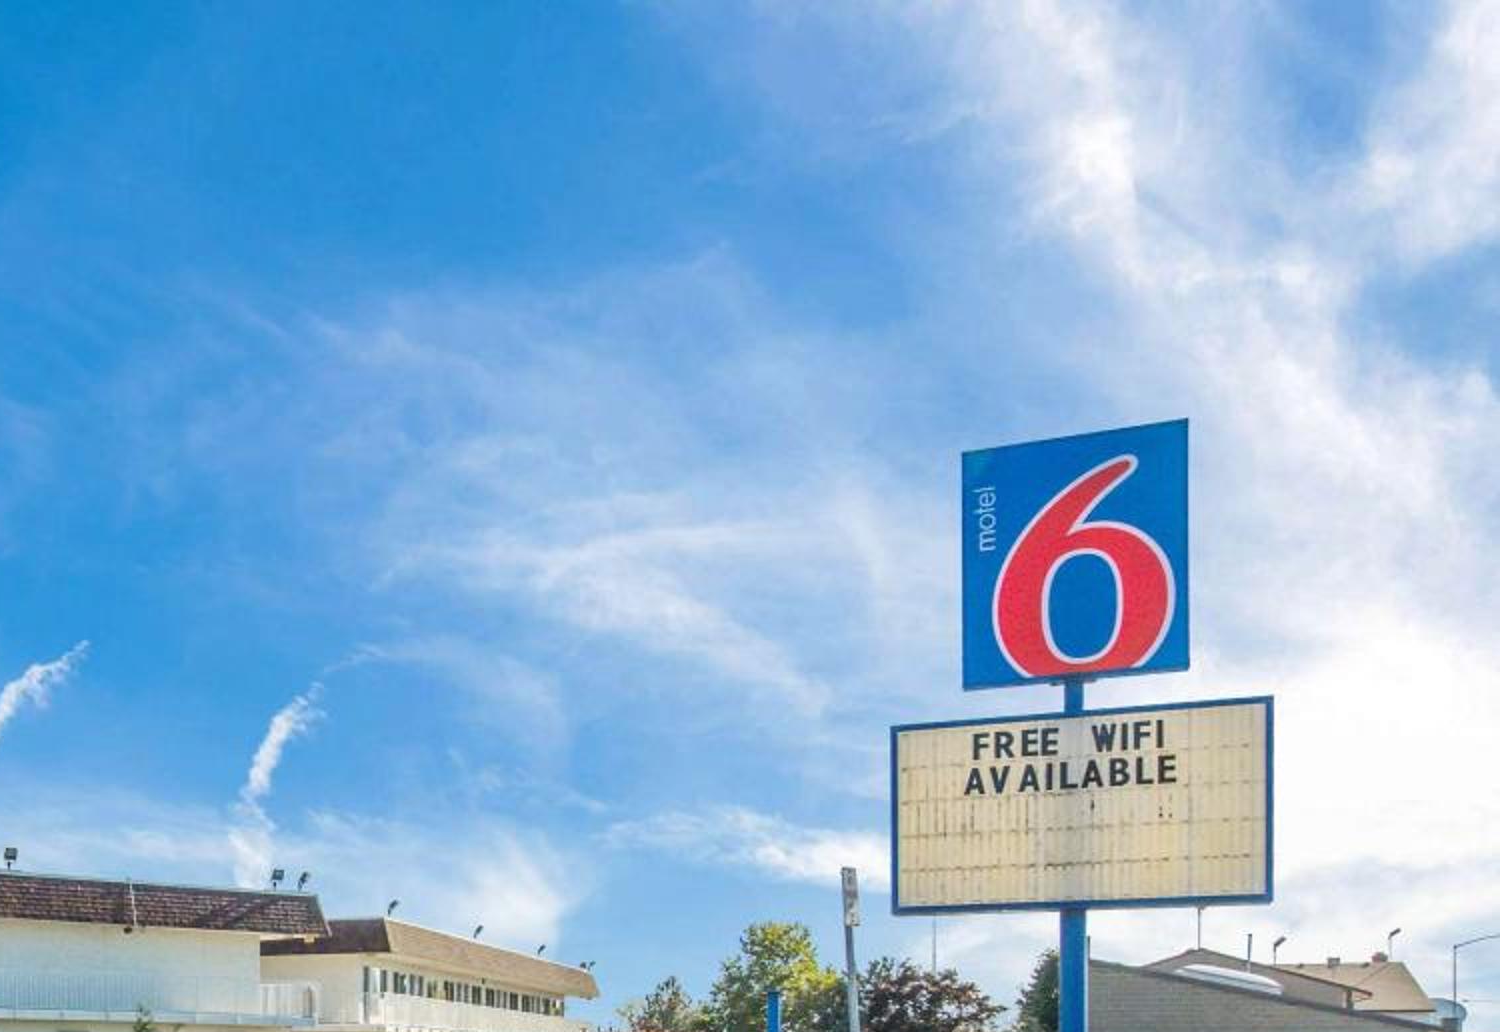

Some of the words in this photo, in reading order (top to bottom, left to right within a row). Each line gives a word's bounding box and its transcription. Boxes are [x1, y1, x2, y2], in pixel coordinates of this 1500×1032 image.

[972, 487, 996, 551] motel
[992, 454, 1176, 678] 6
[972, 727, 1059, 761] FREE
[1092, 720, 1164, 752] WIFI
[964, 754, 1177, 795] AVAILABLE
